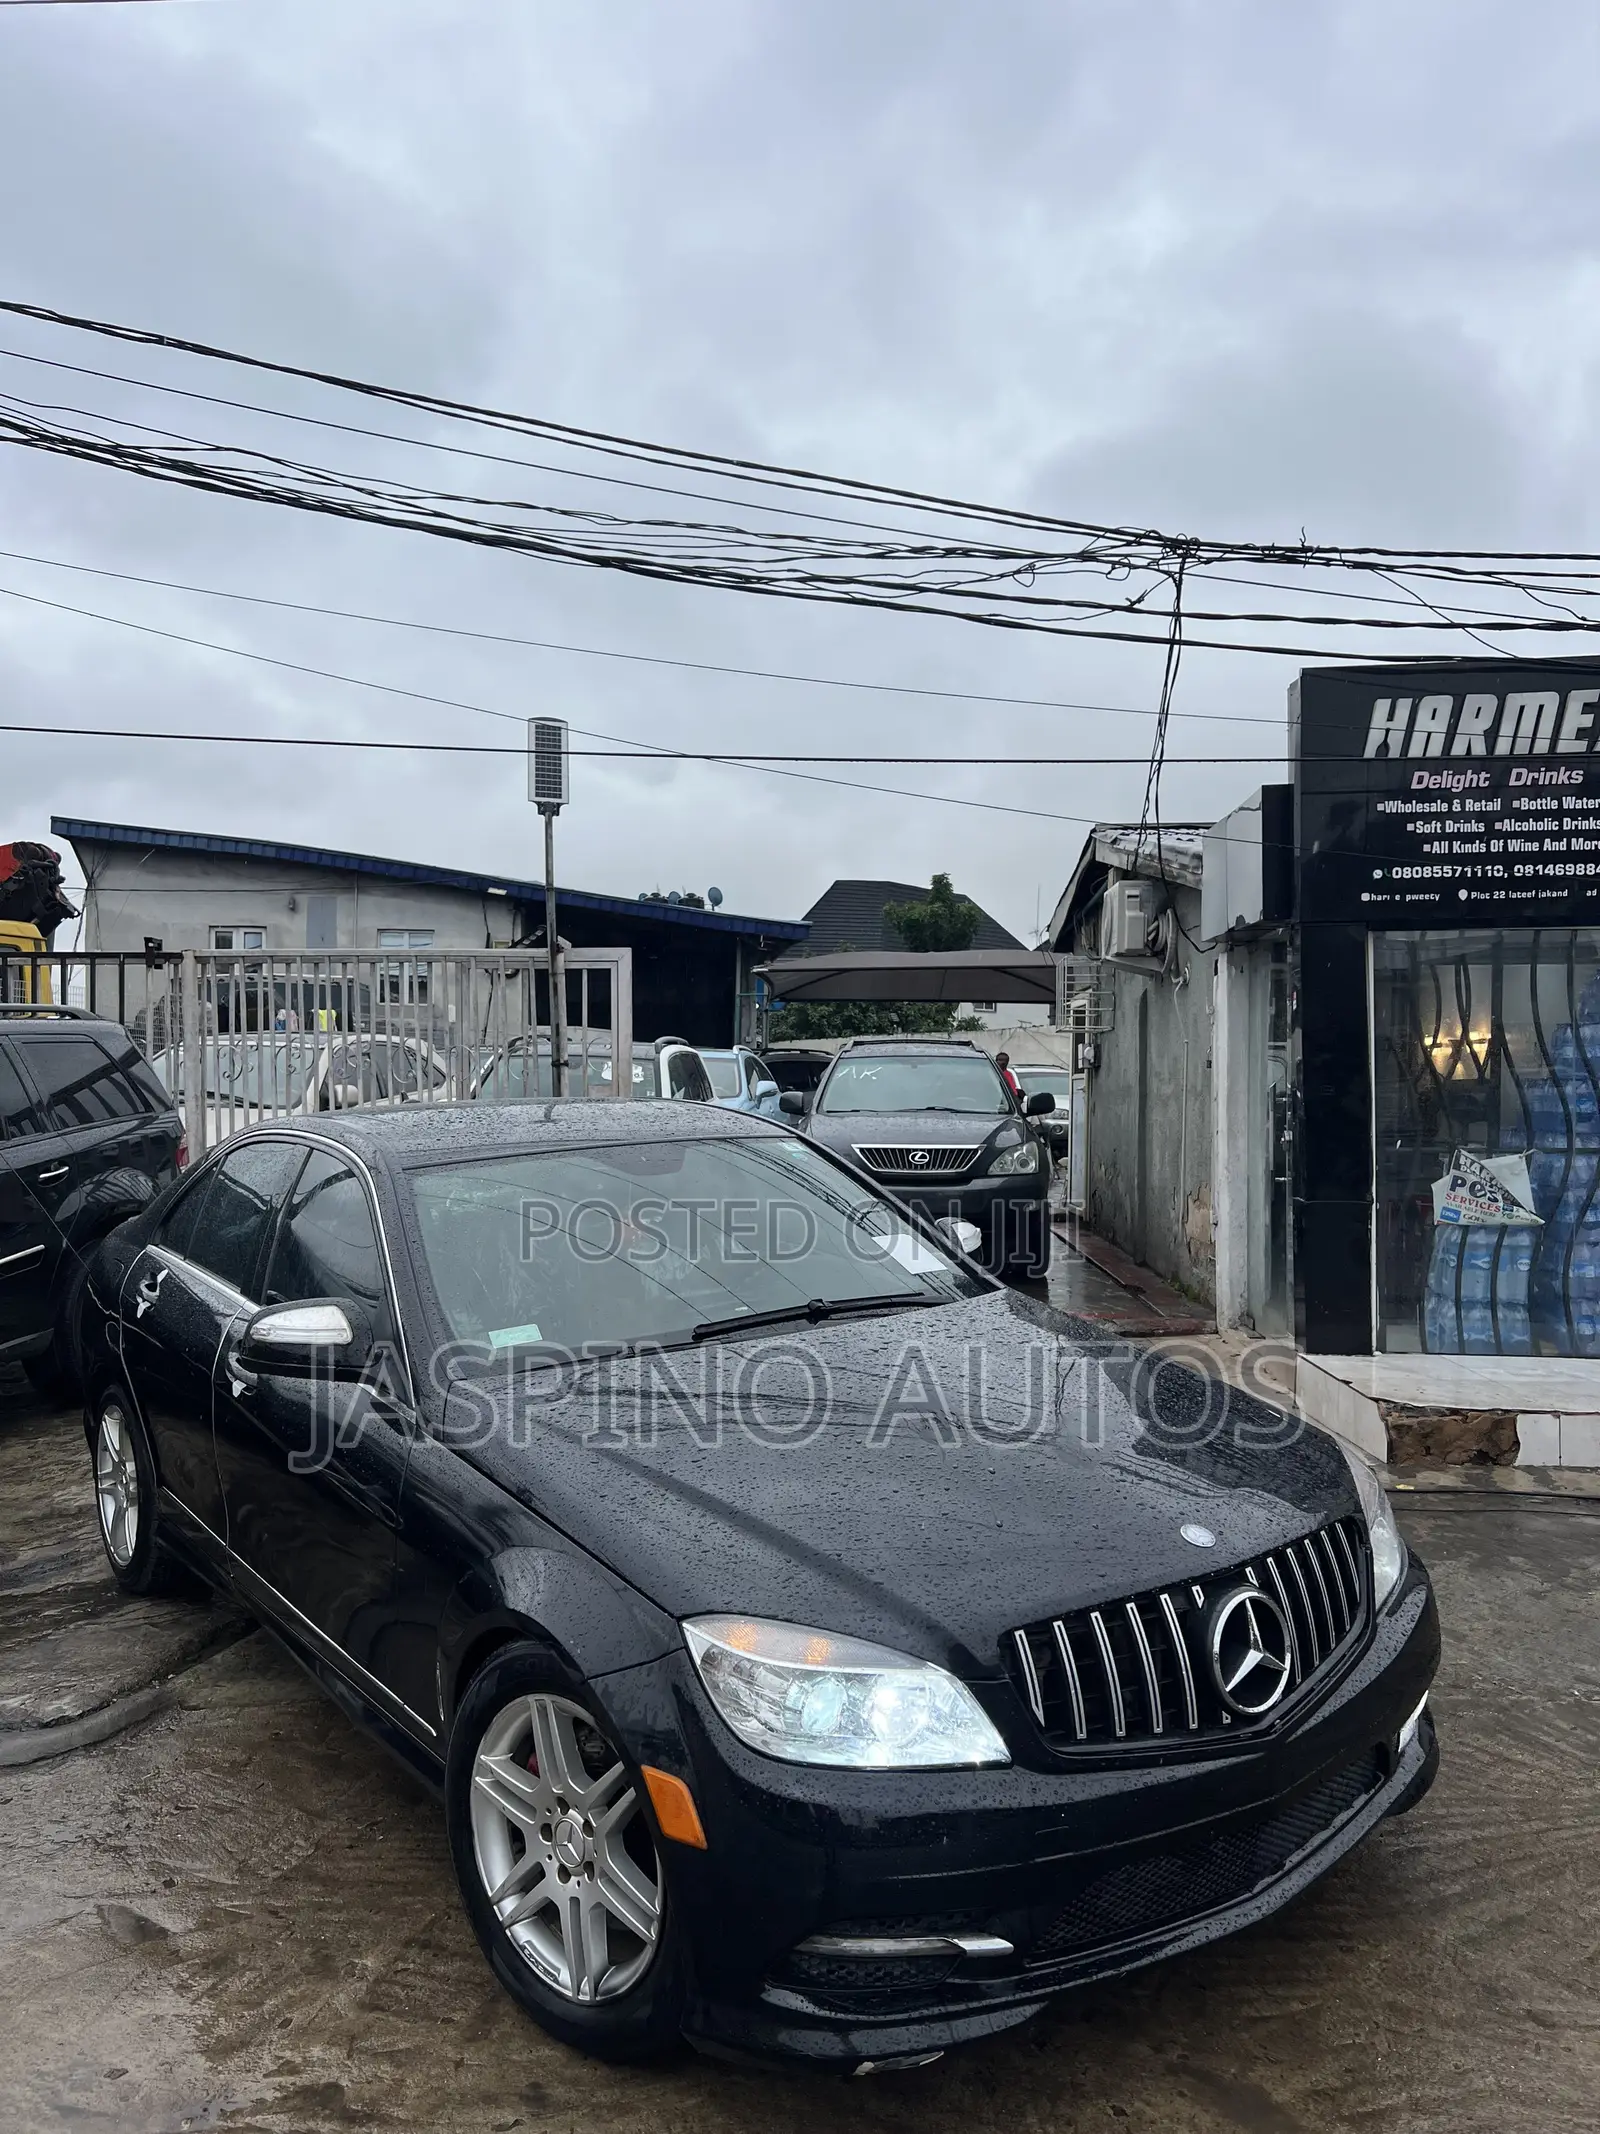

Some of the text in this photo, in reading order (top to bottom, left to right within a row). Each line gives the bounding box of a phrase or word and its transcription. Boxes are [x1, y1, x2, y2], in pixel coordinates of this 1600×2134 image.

[1363, 688, 1600, 758] HARME
[1410, 766, 1584, 792] Delight Drinks
[1384, 799, 1449, 814] Wholesale
[1452, 799, 1462, 813] &
[1465, 798, 1501, 812] Retail
[1520, 797, 1559, 811] Bottle
[1415, 820, 1442, 834] Soft
[1445, 819, 1485, 833] Drinks
[1502, 817, 1559, 831] Alcoholic
[1431, 841, 1449, 854] All
[1452, 839, 1486, 854] Kinds
[1490, 839, 1504, 853] Of
[1507, 838, 1539, 852] Wine
[1543, 838, 1567, 851] And
[1492, 890, 1506, 899] 22
[1445, 1192, 1501, 1213] SERVICES
